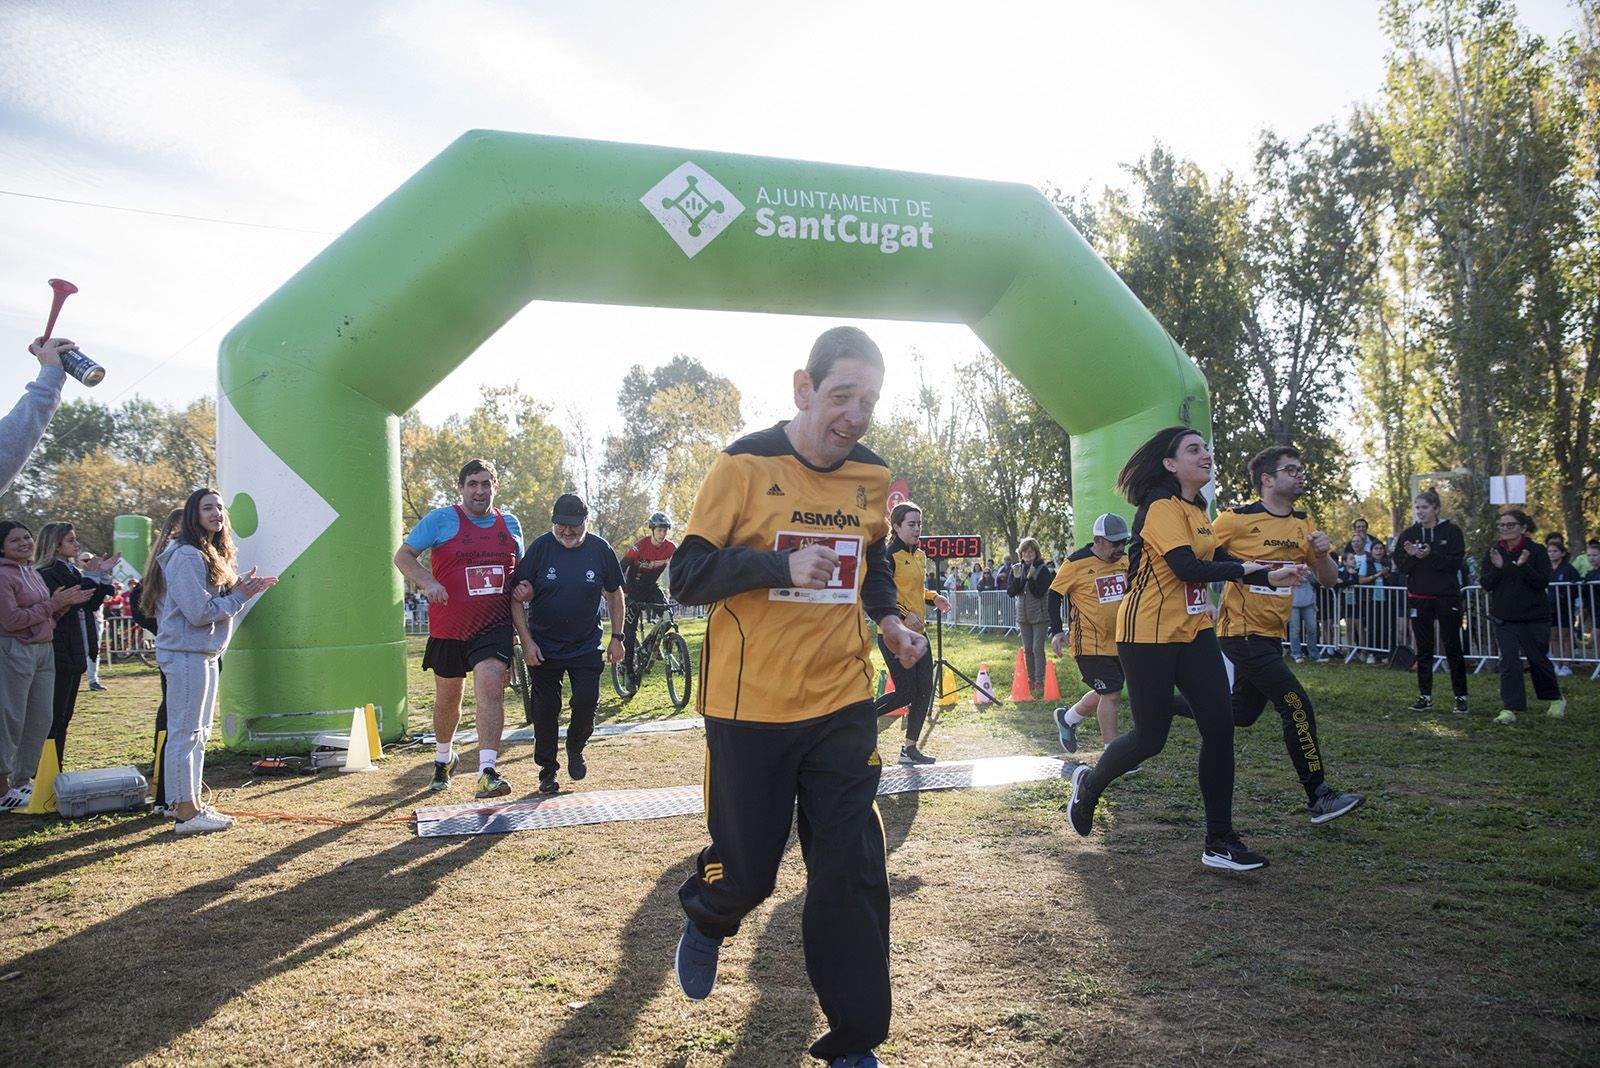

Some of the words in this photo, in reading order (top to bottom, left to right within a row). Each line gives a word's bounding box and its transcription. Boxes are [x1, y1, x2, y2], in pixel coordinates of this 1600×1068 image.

[756, 187, 900, 215] AJUNTAMENT
[906, 200, 933, 217] DE
[755, 207, 934, 254] SantCugat
[483, 576, 492, 588] 1
[1103, 583, 1123, 597] 219
[1283, 691, 1321, 773] SPORTIVE
